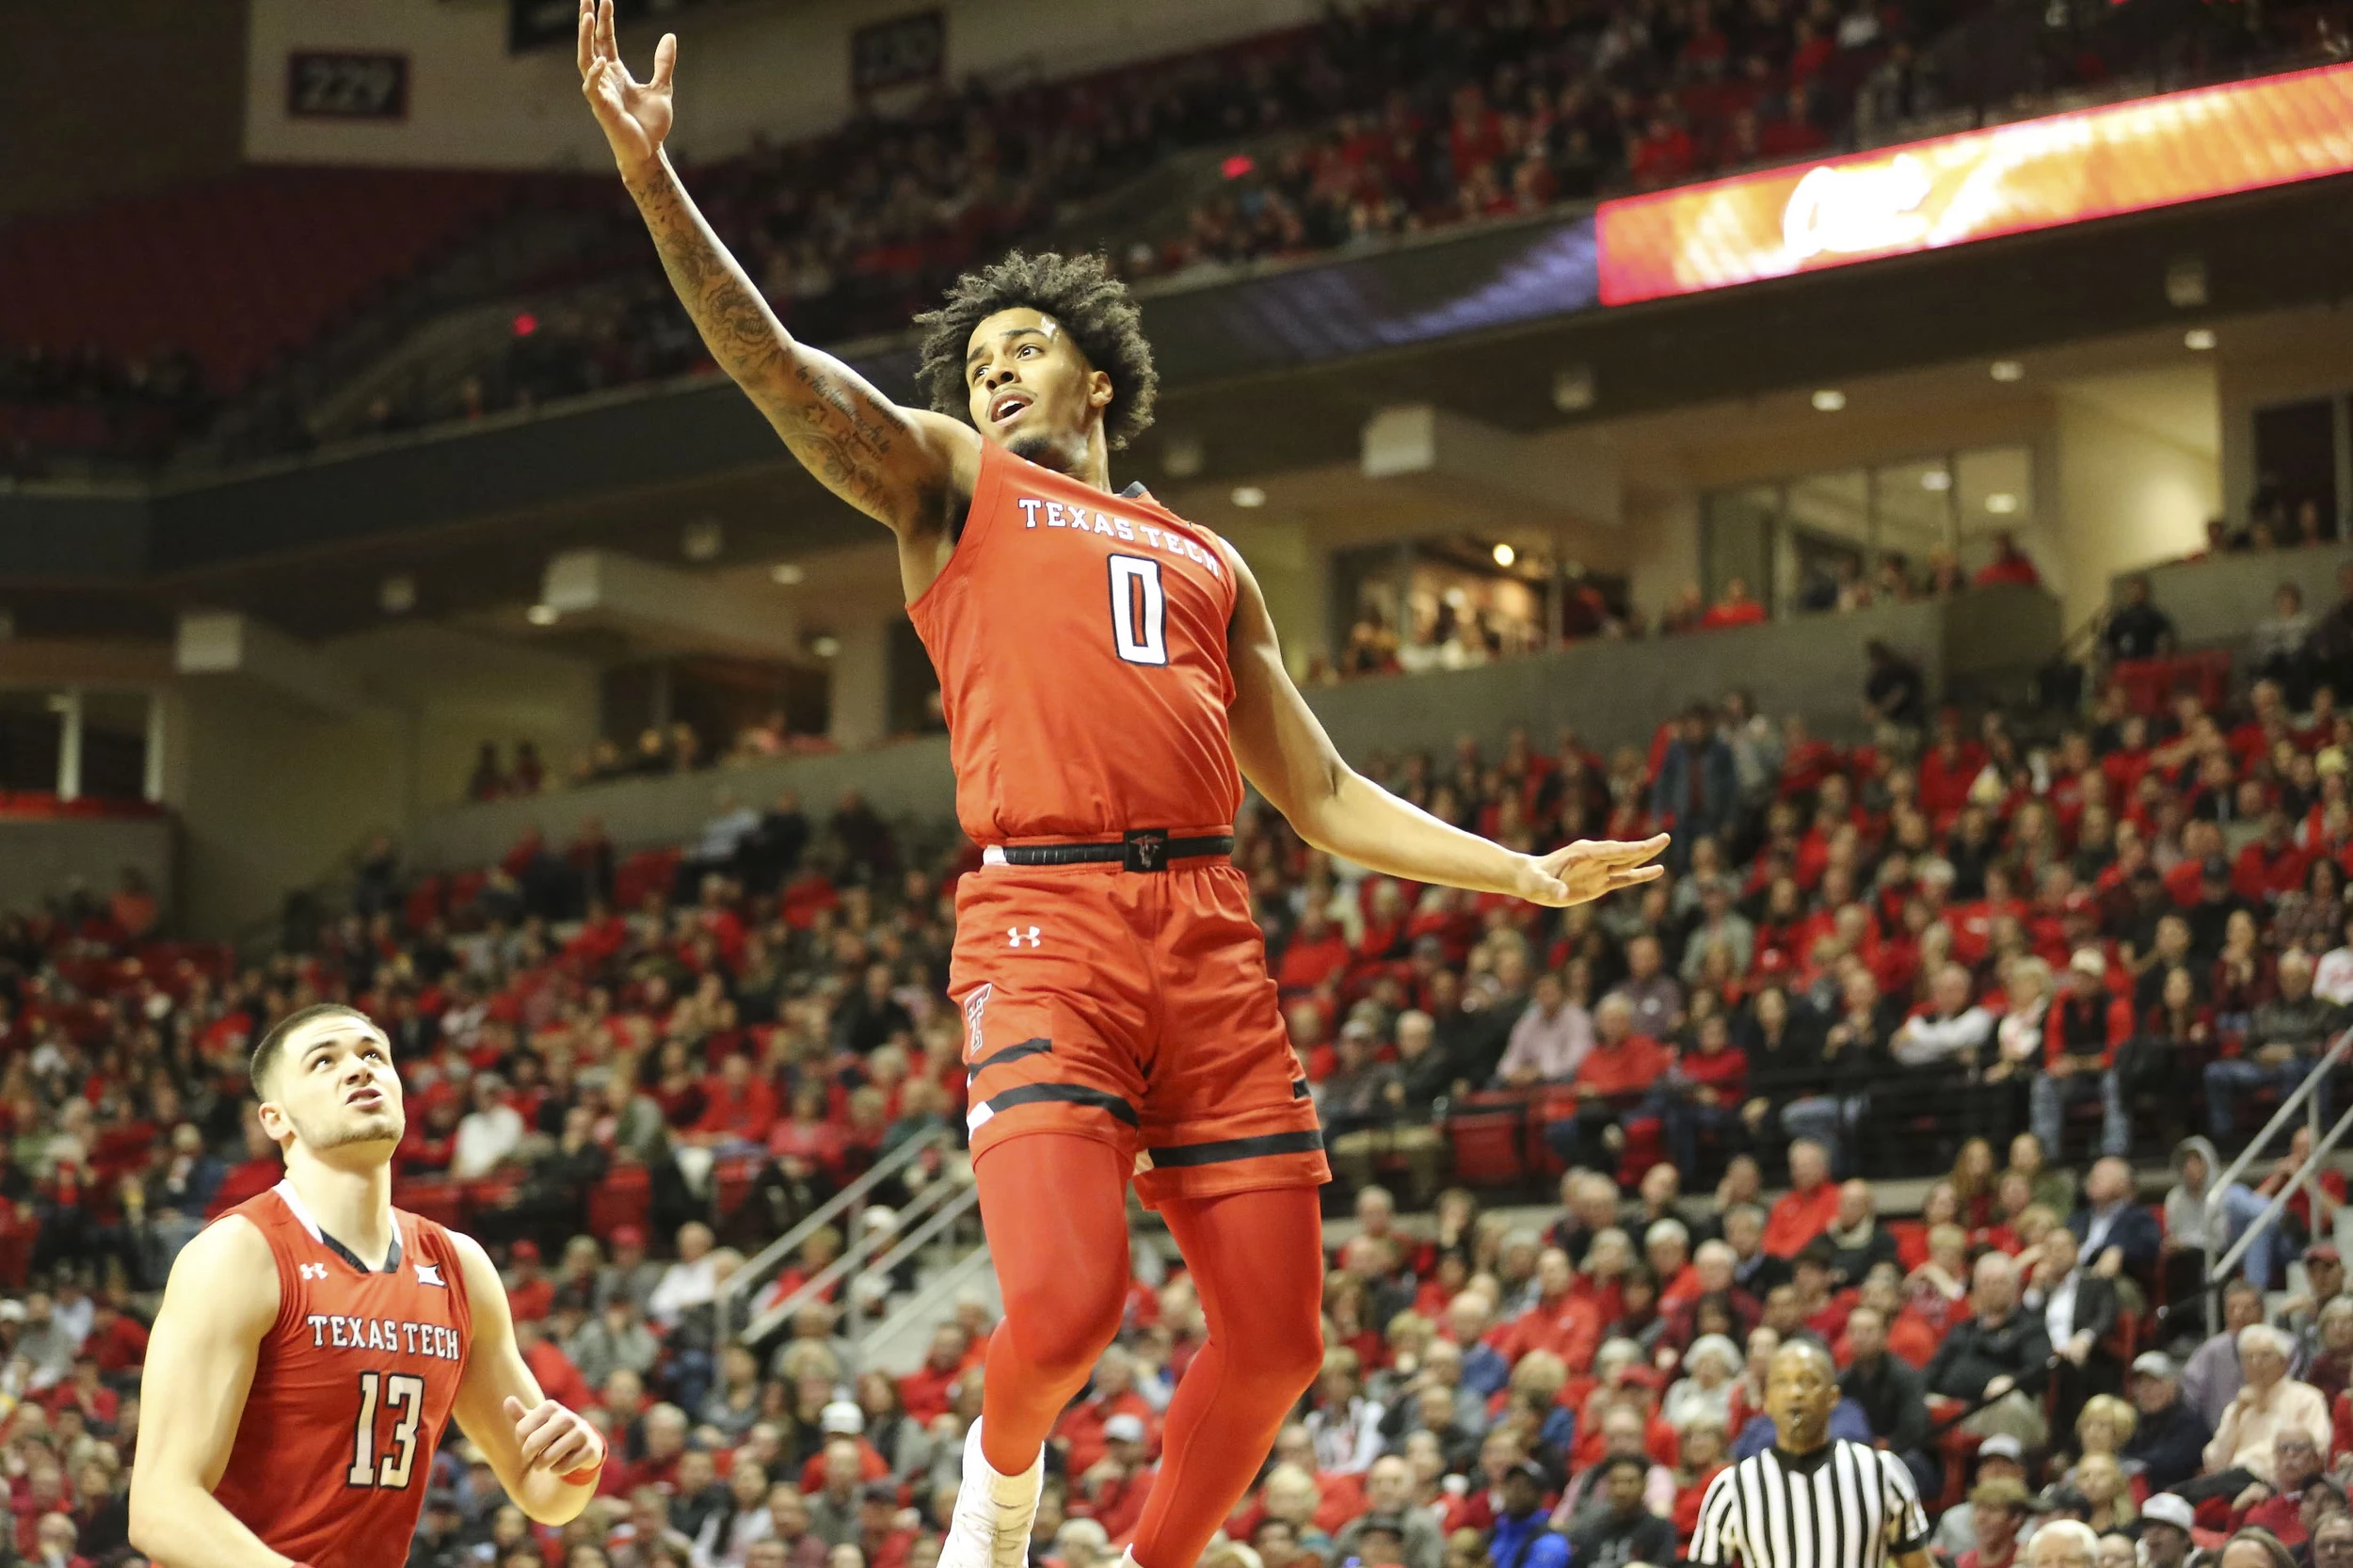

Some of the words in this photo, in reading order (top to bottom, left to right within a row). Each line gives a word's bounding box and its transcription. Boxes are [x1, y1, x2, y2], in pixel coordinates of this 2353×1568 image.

[1017, 497, 1136, 543] TEXAS
[1139, 524, 1221, 579] TECH
[1107, 552, 1170, 668] 0
[306, 1314, 399, 1352] TEXAS
[402, 1320, 460, 1361] TECH
[345, 1370, 425, 1491] 13
